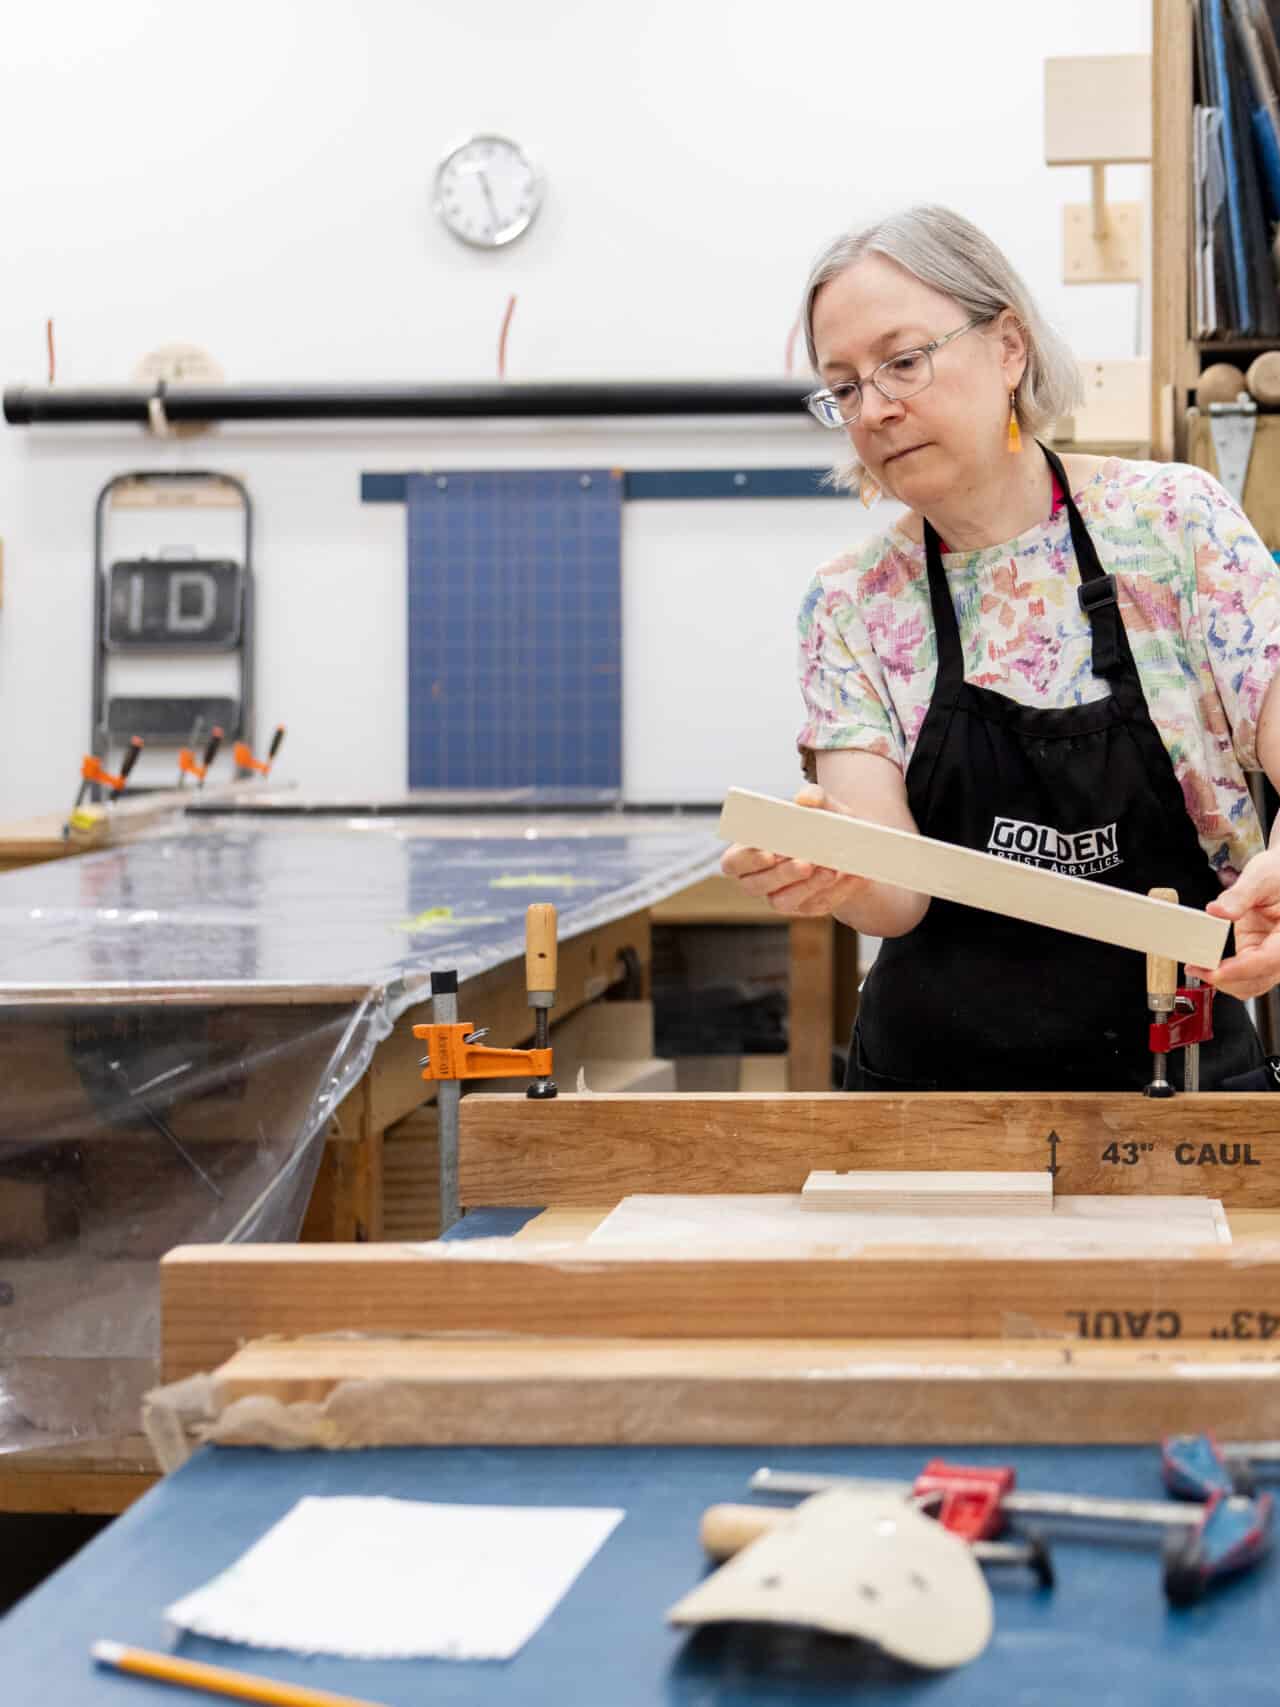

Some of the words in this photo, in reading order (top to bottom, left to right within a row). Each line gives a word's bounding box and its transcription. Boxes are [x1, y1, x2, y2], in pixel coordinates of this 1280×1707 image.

[993, 821, 1115, 861] GOLDEN
[989, 850, 1041, 868] RTIST
[1102, 1141, 1154, 1166] 43"
[1174, 1142, 1262, 1166] CAUL
[1064, 1308, 1182, 1340] CAUL
